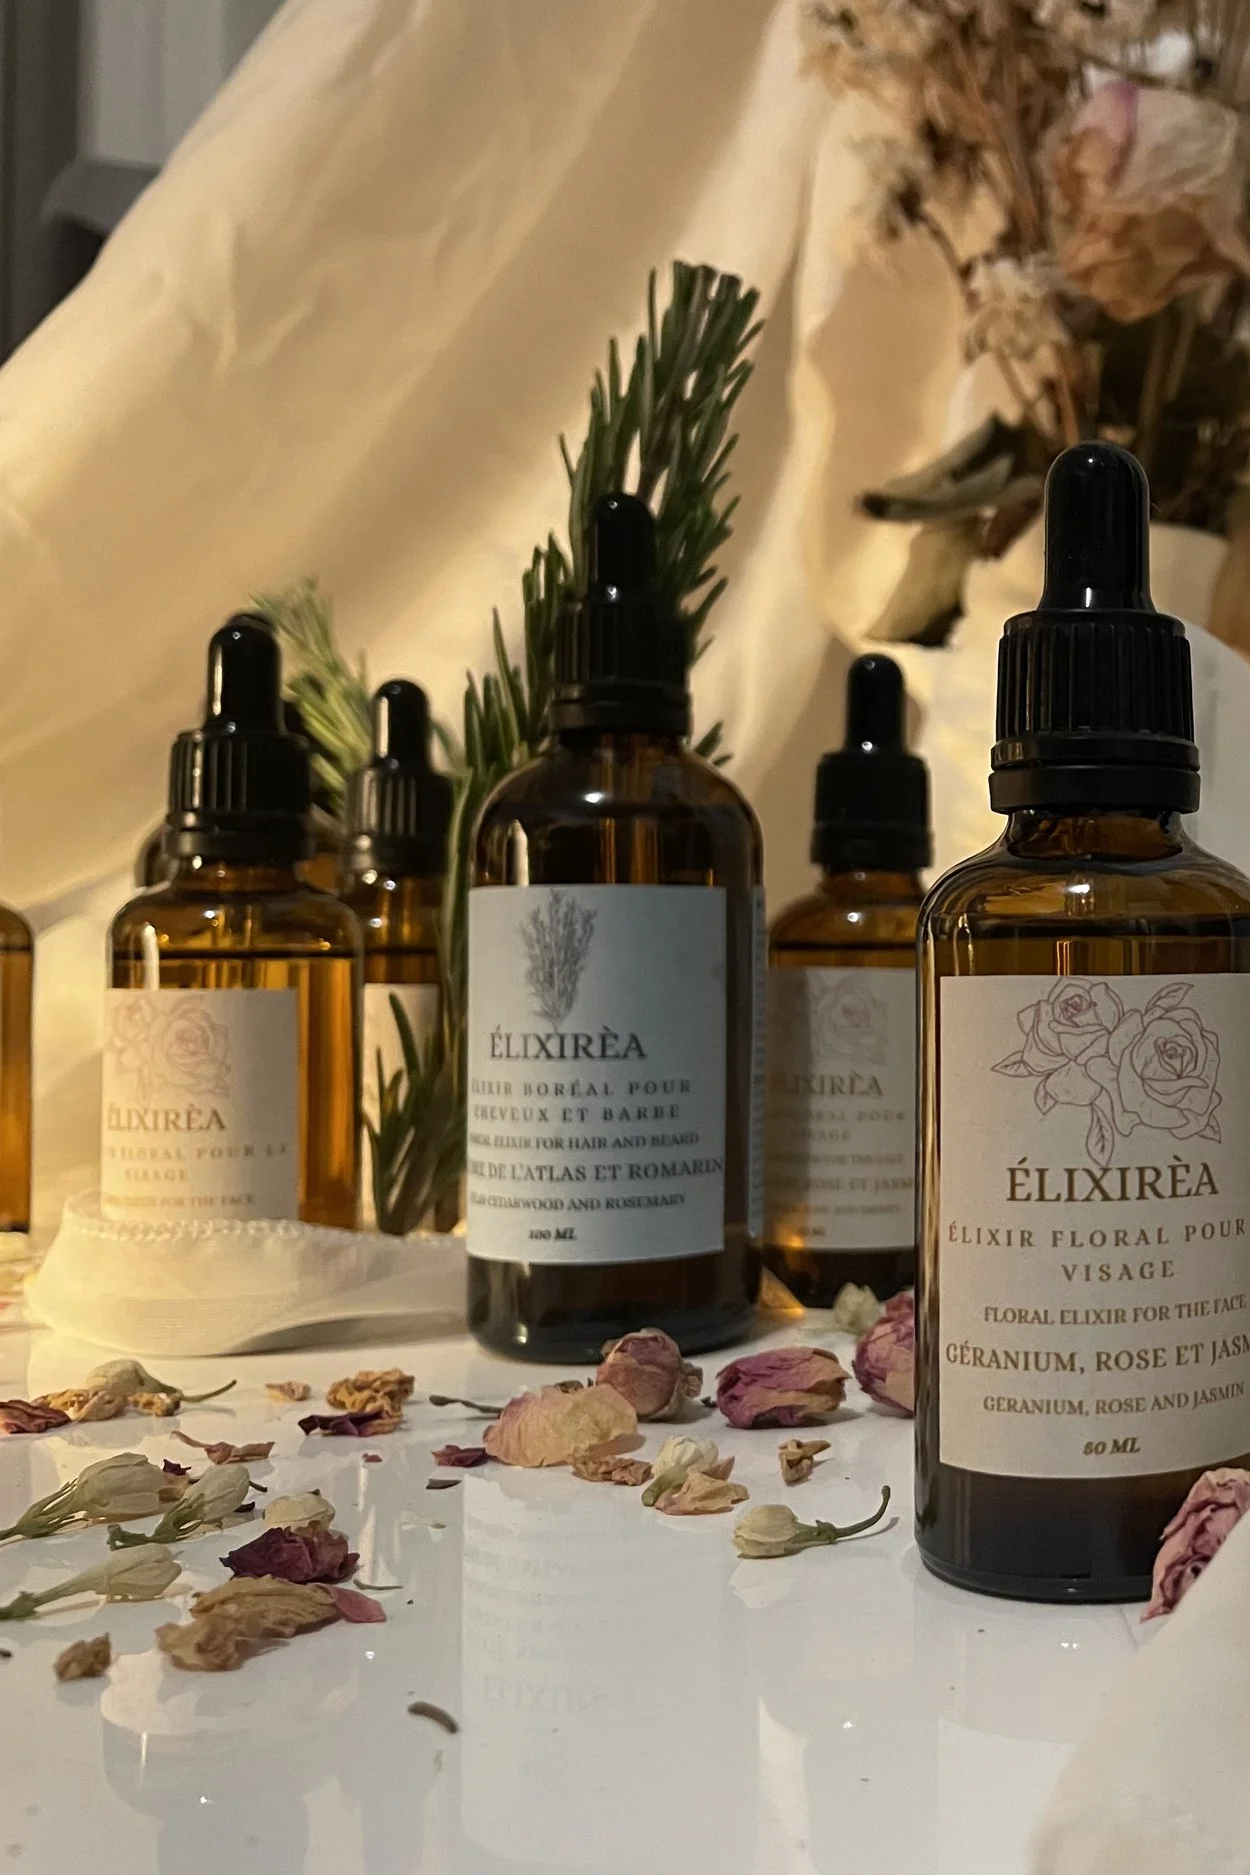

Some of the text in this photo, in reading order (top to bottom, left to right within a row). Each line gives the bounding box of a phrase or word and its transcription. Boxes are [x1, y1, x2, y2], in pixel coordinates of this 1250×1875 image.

[489, 1024, 647, 1061] ÉLIXIRÈA
[523, 1079, 615, 1097] BORÉAL
[628, 1079, 692, 1097] POUR
[473, 1104, 680, 1123] CHEVEUX ET BARBE
[535, 1136, 565, 1151] FOR
[568, 1136, 608, 1151] HAIR
[611, 1135, 647, 1150] AND
[650, 1132, 700, 1148] BEARD
[488, 1161, 508, 1180] DE
[594, 1163, 623, 1181] ET
[628, 1156, 723, 1182] ROMARIN
[1006, 1155, 1219, 1202] ÉLIXIRÈA
[567, 1197, 601, 1211] AND
[605, 1193, 686, 1210] ROSEMARY
[528, 1227, 578, 1241] 100 ML
[949, 1221, 1035, 1248] ÉLIXIR
[1051, 1227, 1169, 1248] FLORAL
[1184, 1218, 1246, 1242] POUR
[1061, 1260, 1175, 1282] VISAGE
[984, 1294, 1247, 1325] FLORAL ELIXIR FOR THE FACE
[946, 1340, 1085, 1375] GÉRANIUM,
[1095, 1347, 1168, 1372] ROSE
[1175, 1343, 1204, 1366] ET
[983, 1381, 1245, 1416] GERANIUM, ROSE AND JASMIN
[1109, 1437, 1141, 1454] ML
